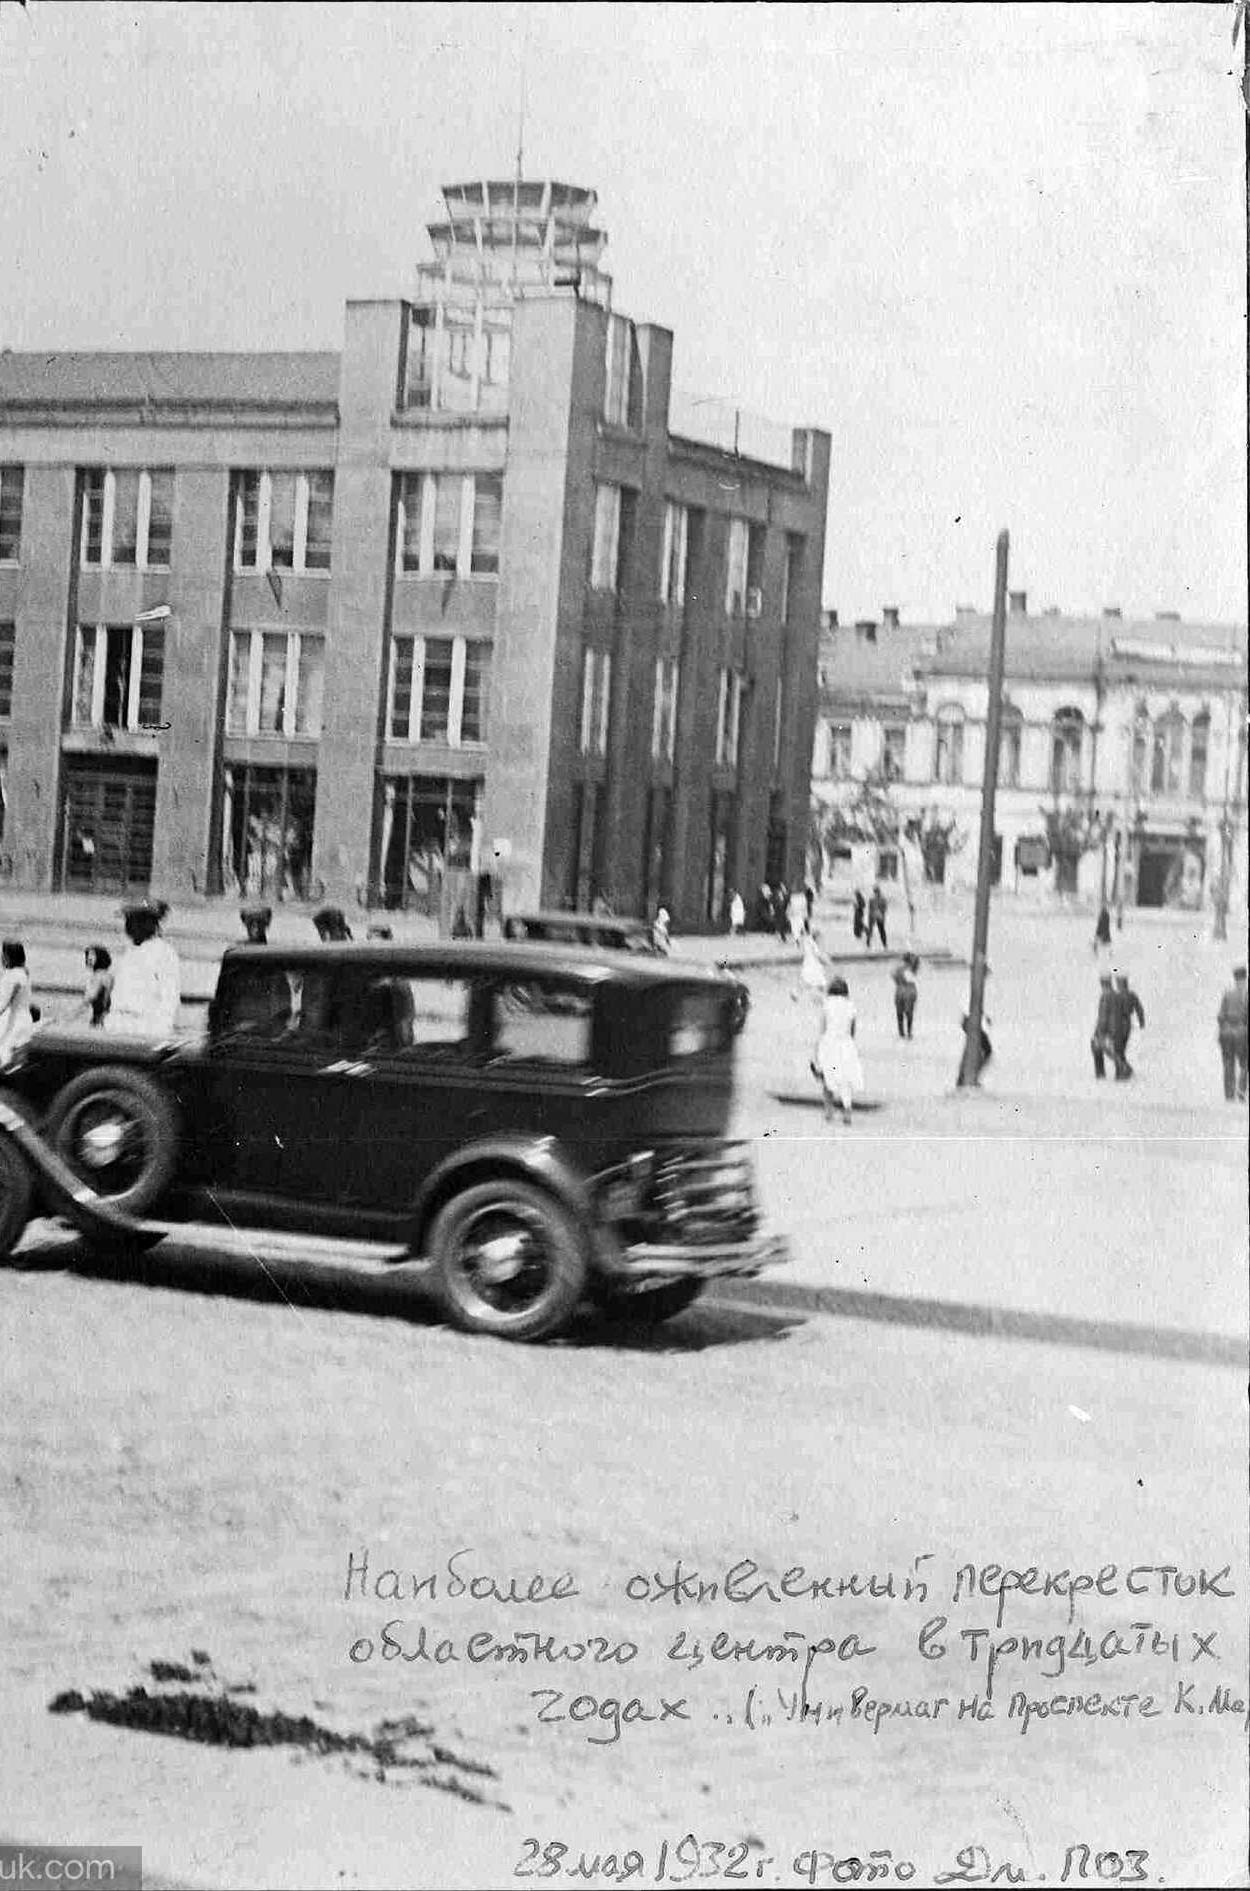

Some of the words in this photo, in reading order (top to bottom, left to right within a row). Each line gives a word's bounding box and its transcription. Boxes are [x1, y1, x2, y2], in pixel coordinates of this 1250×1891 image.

[345, 1548, 580, 1603] Наиболее
[349, 1620, 640, 1664] областного
[668, 1630, 877, 1714] центра
[918, 1616, 948, 1660] в
